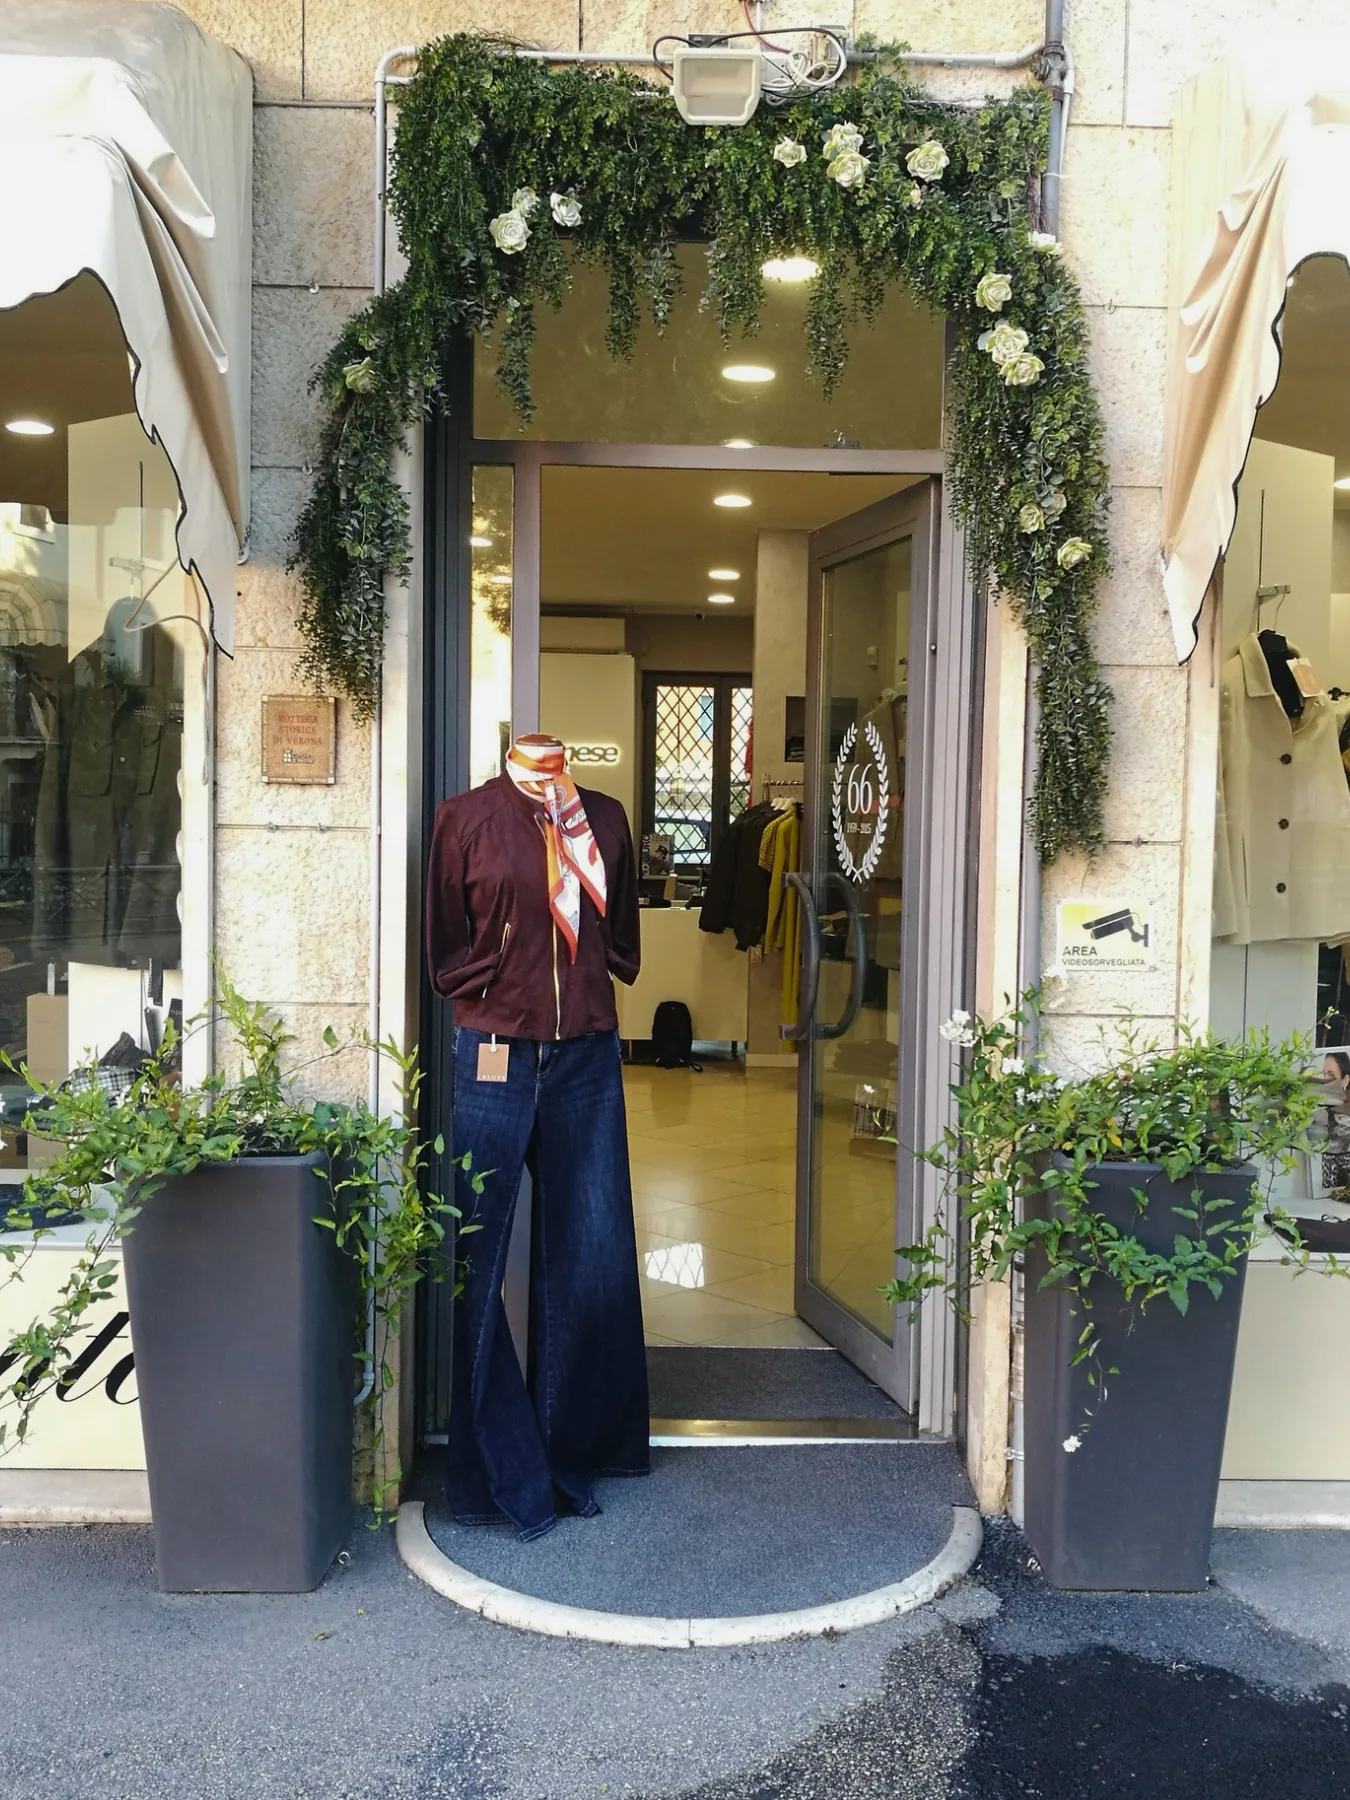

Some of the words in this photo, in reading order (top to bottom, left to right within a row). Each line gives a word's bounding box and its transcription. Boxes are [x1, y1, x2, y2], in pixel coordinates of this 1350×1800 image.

[278, 715, 319, 724] BOTTEGA
[278, 726, 317, 734] STORICA
[273, 736, 283, 745] DI
[286, 737, 323, 745] VERONA
[847, 763, 872, 814] 66
[1062, 946, 1098, 956] AREA
[1062, 958, 1146, 966] VIDEOSORVEGLIATA
